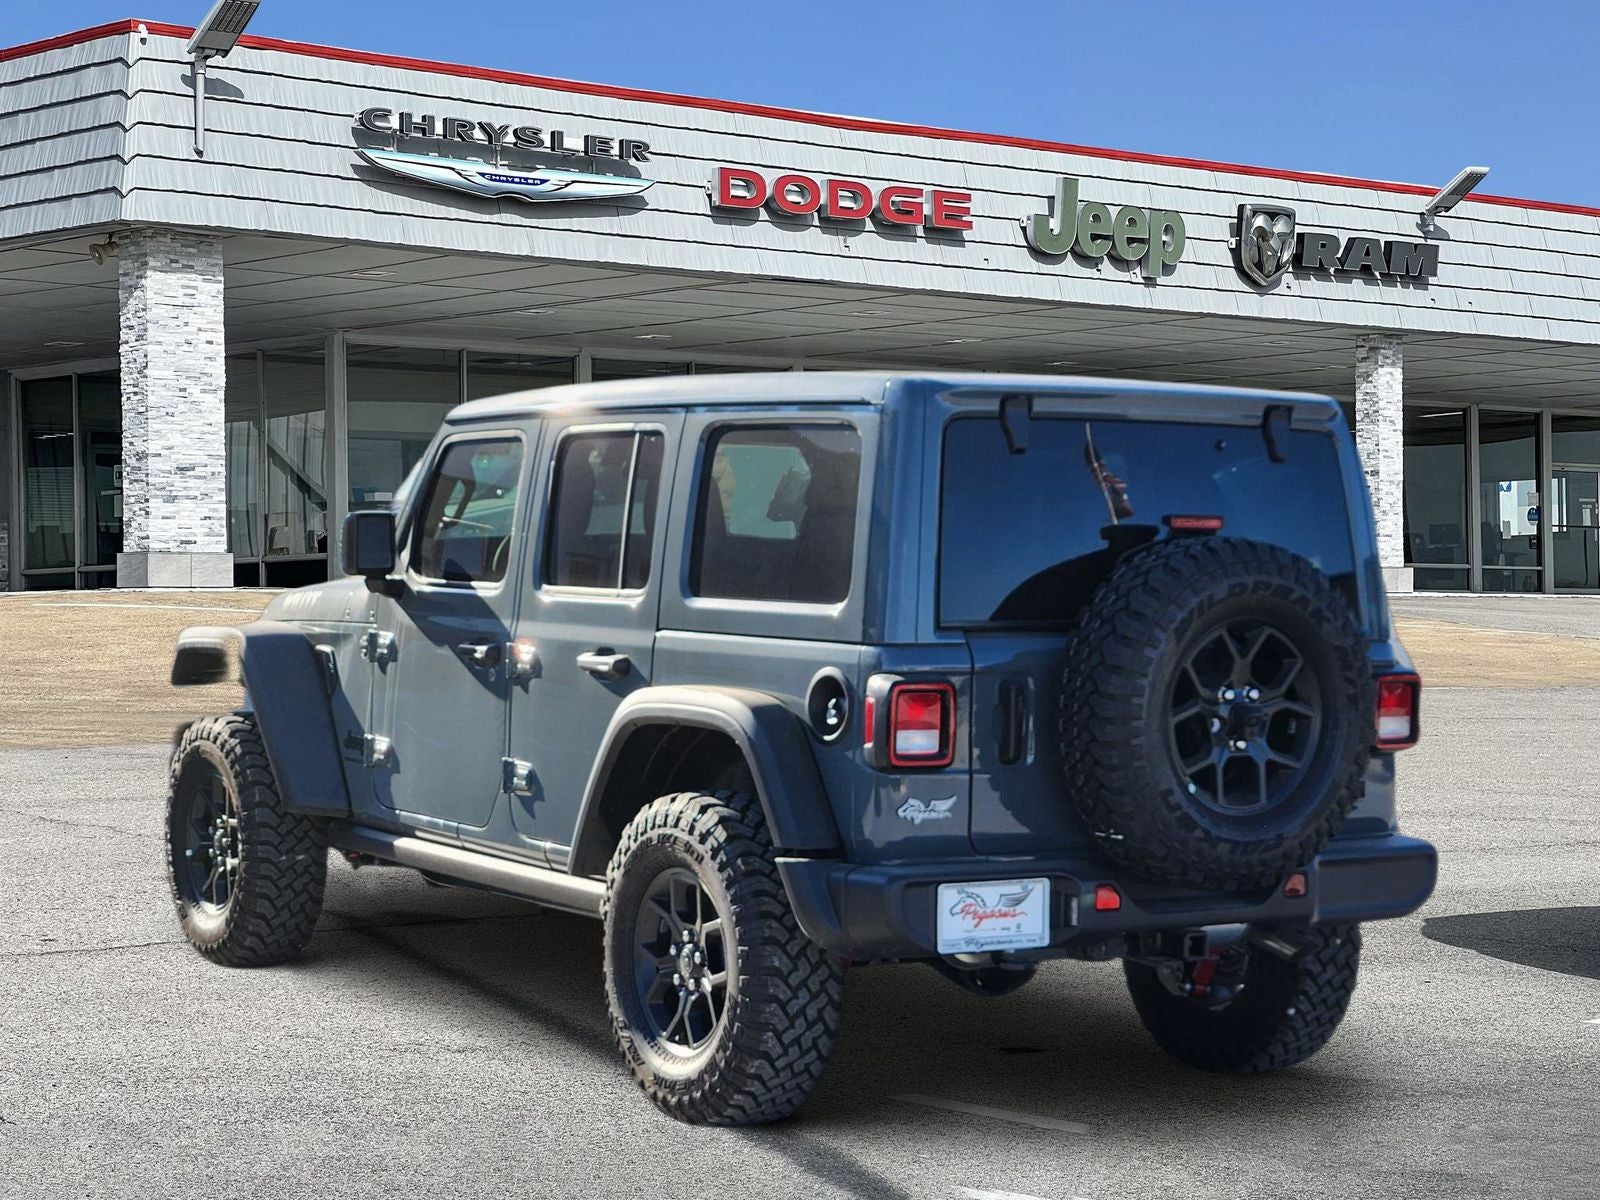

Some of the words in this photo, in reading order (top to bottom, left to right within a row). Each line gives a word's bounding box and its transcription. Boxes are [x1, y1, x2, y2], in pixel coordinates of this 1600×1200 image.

[360, 107, 651, 162] CHRYSLER
[484, 174, 541, 185] CHRYSLER
[712, 167, 973, 230] DODGE
[1027, 177, 1186, 278] Jeep
[1298, 231, 1440, 277] RAM
